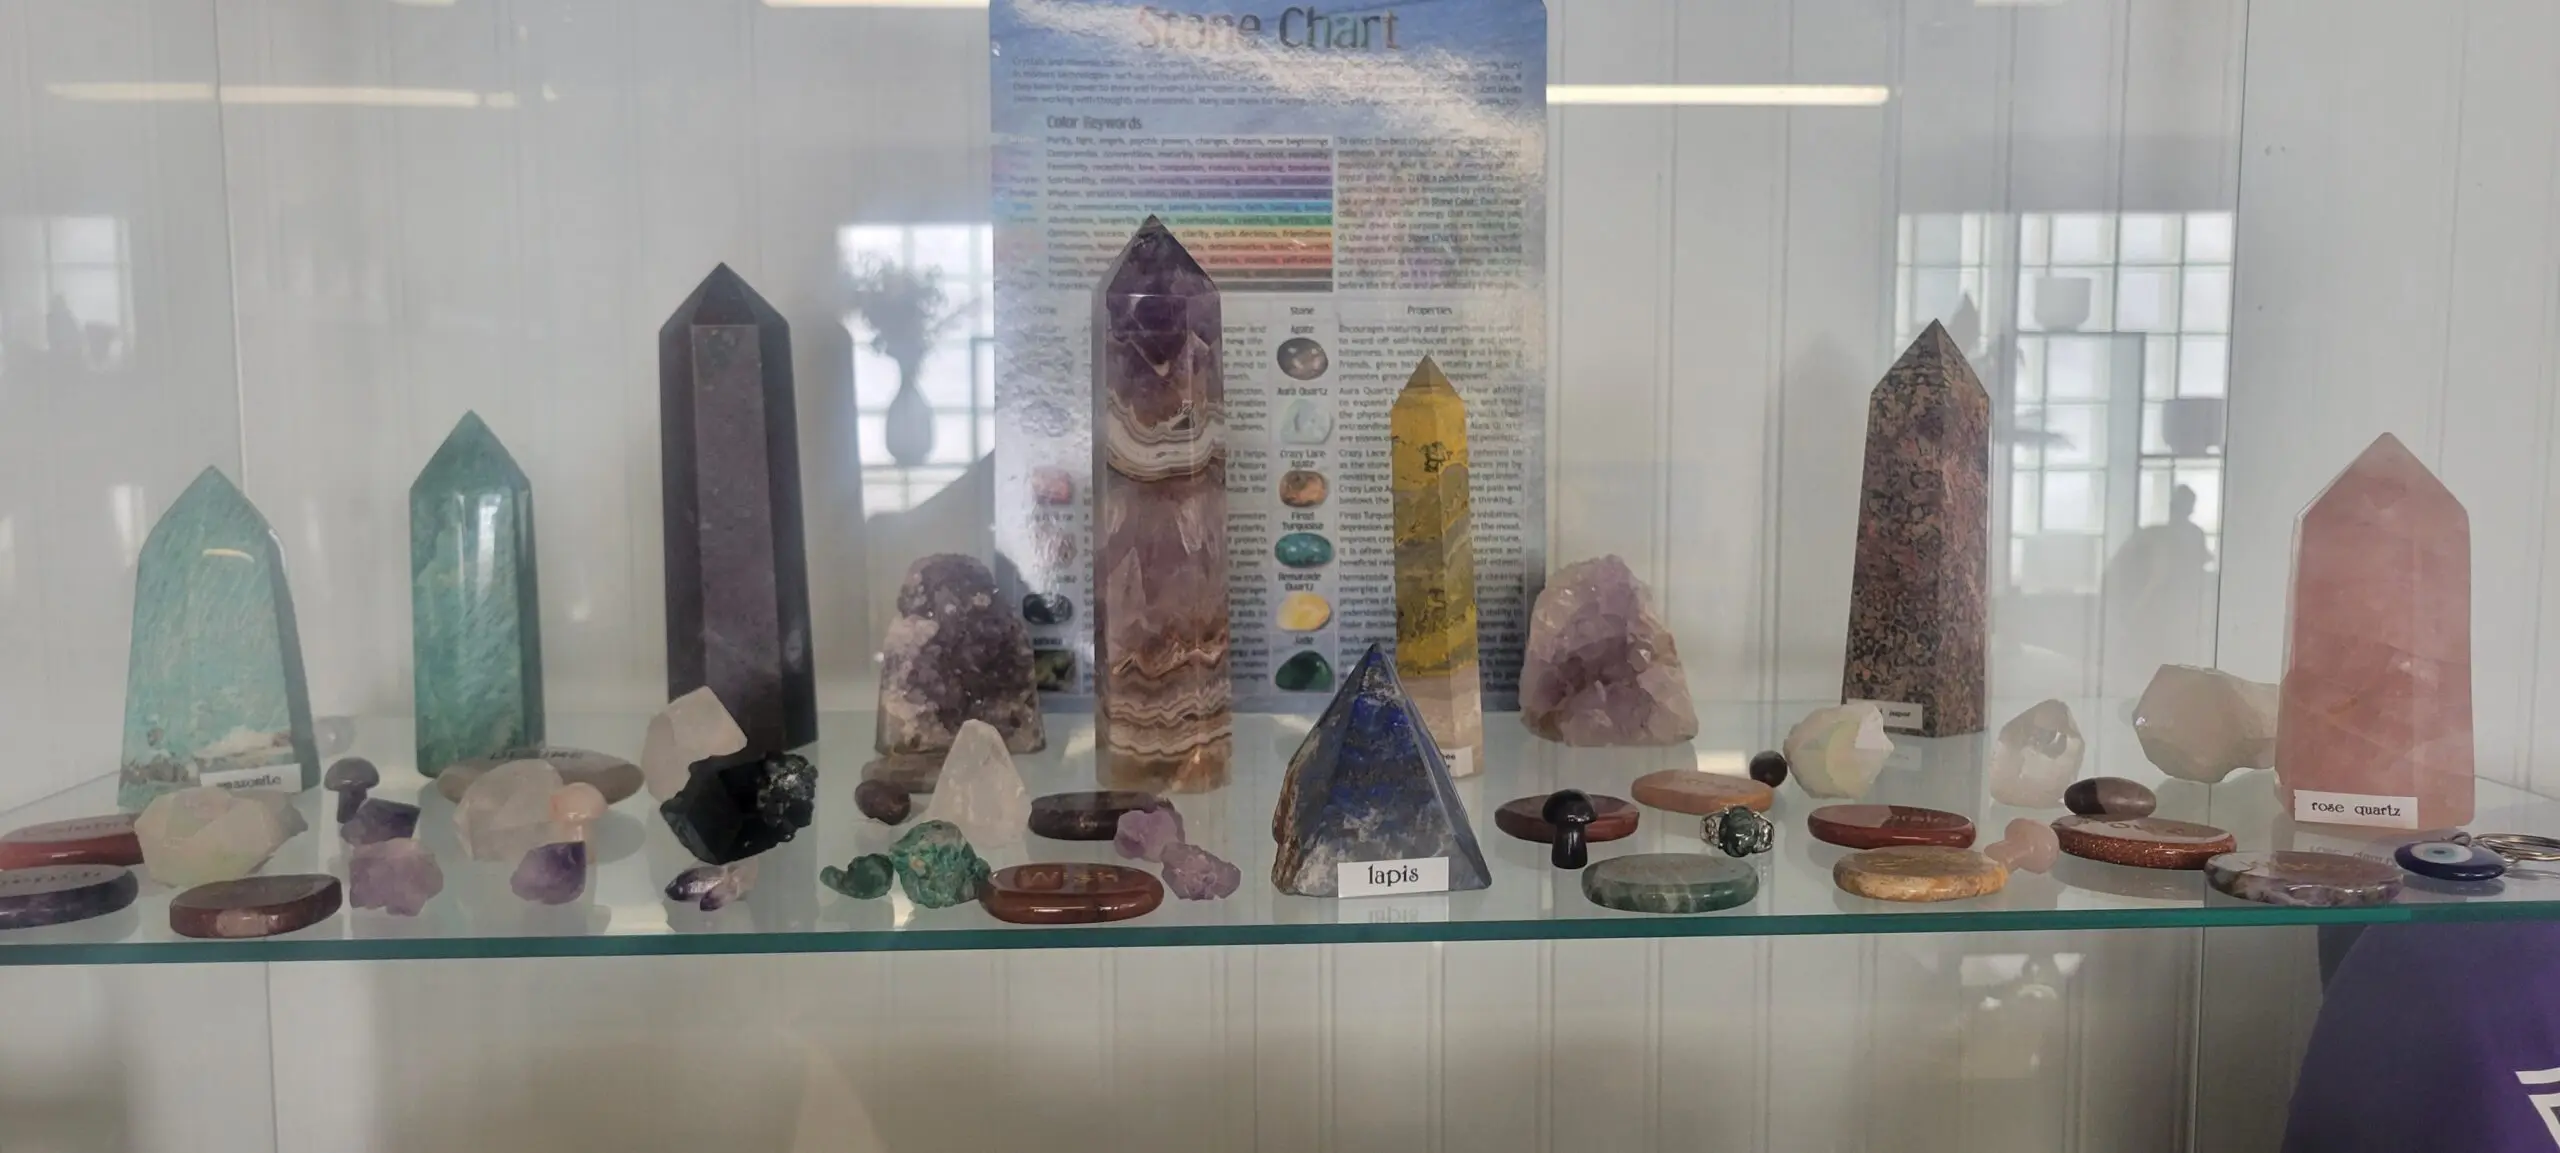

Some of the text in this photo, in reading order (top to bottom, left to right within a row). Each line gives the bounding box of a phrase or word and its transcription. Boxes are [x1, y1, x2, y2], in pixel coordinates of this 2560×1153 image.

[1279, 6, 1401, 49] Chart
[1047, 116, 1142, 131] Color Keywords
[1407, 305, 1453, 316] Properties
[2311, 801, 2401, 817] rose quartz
[1368, 864, 1419, 886] lapis
